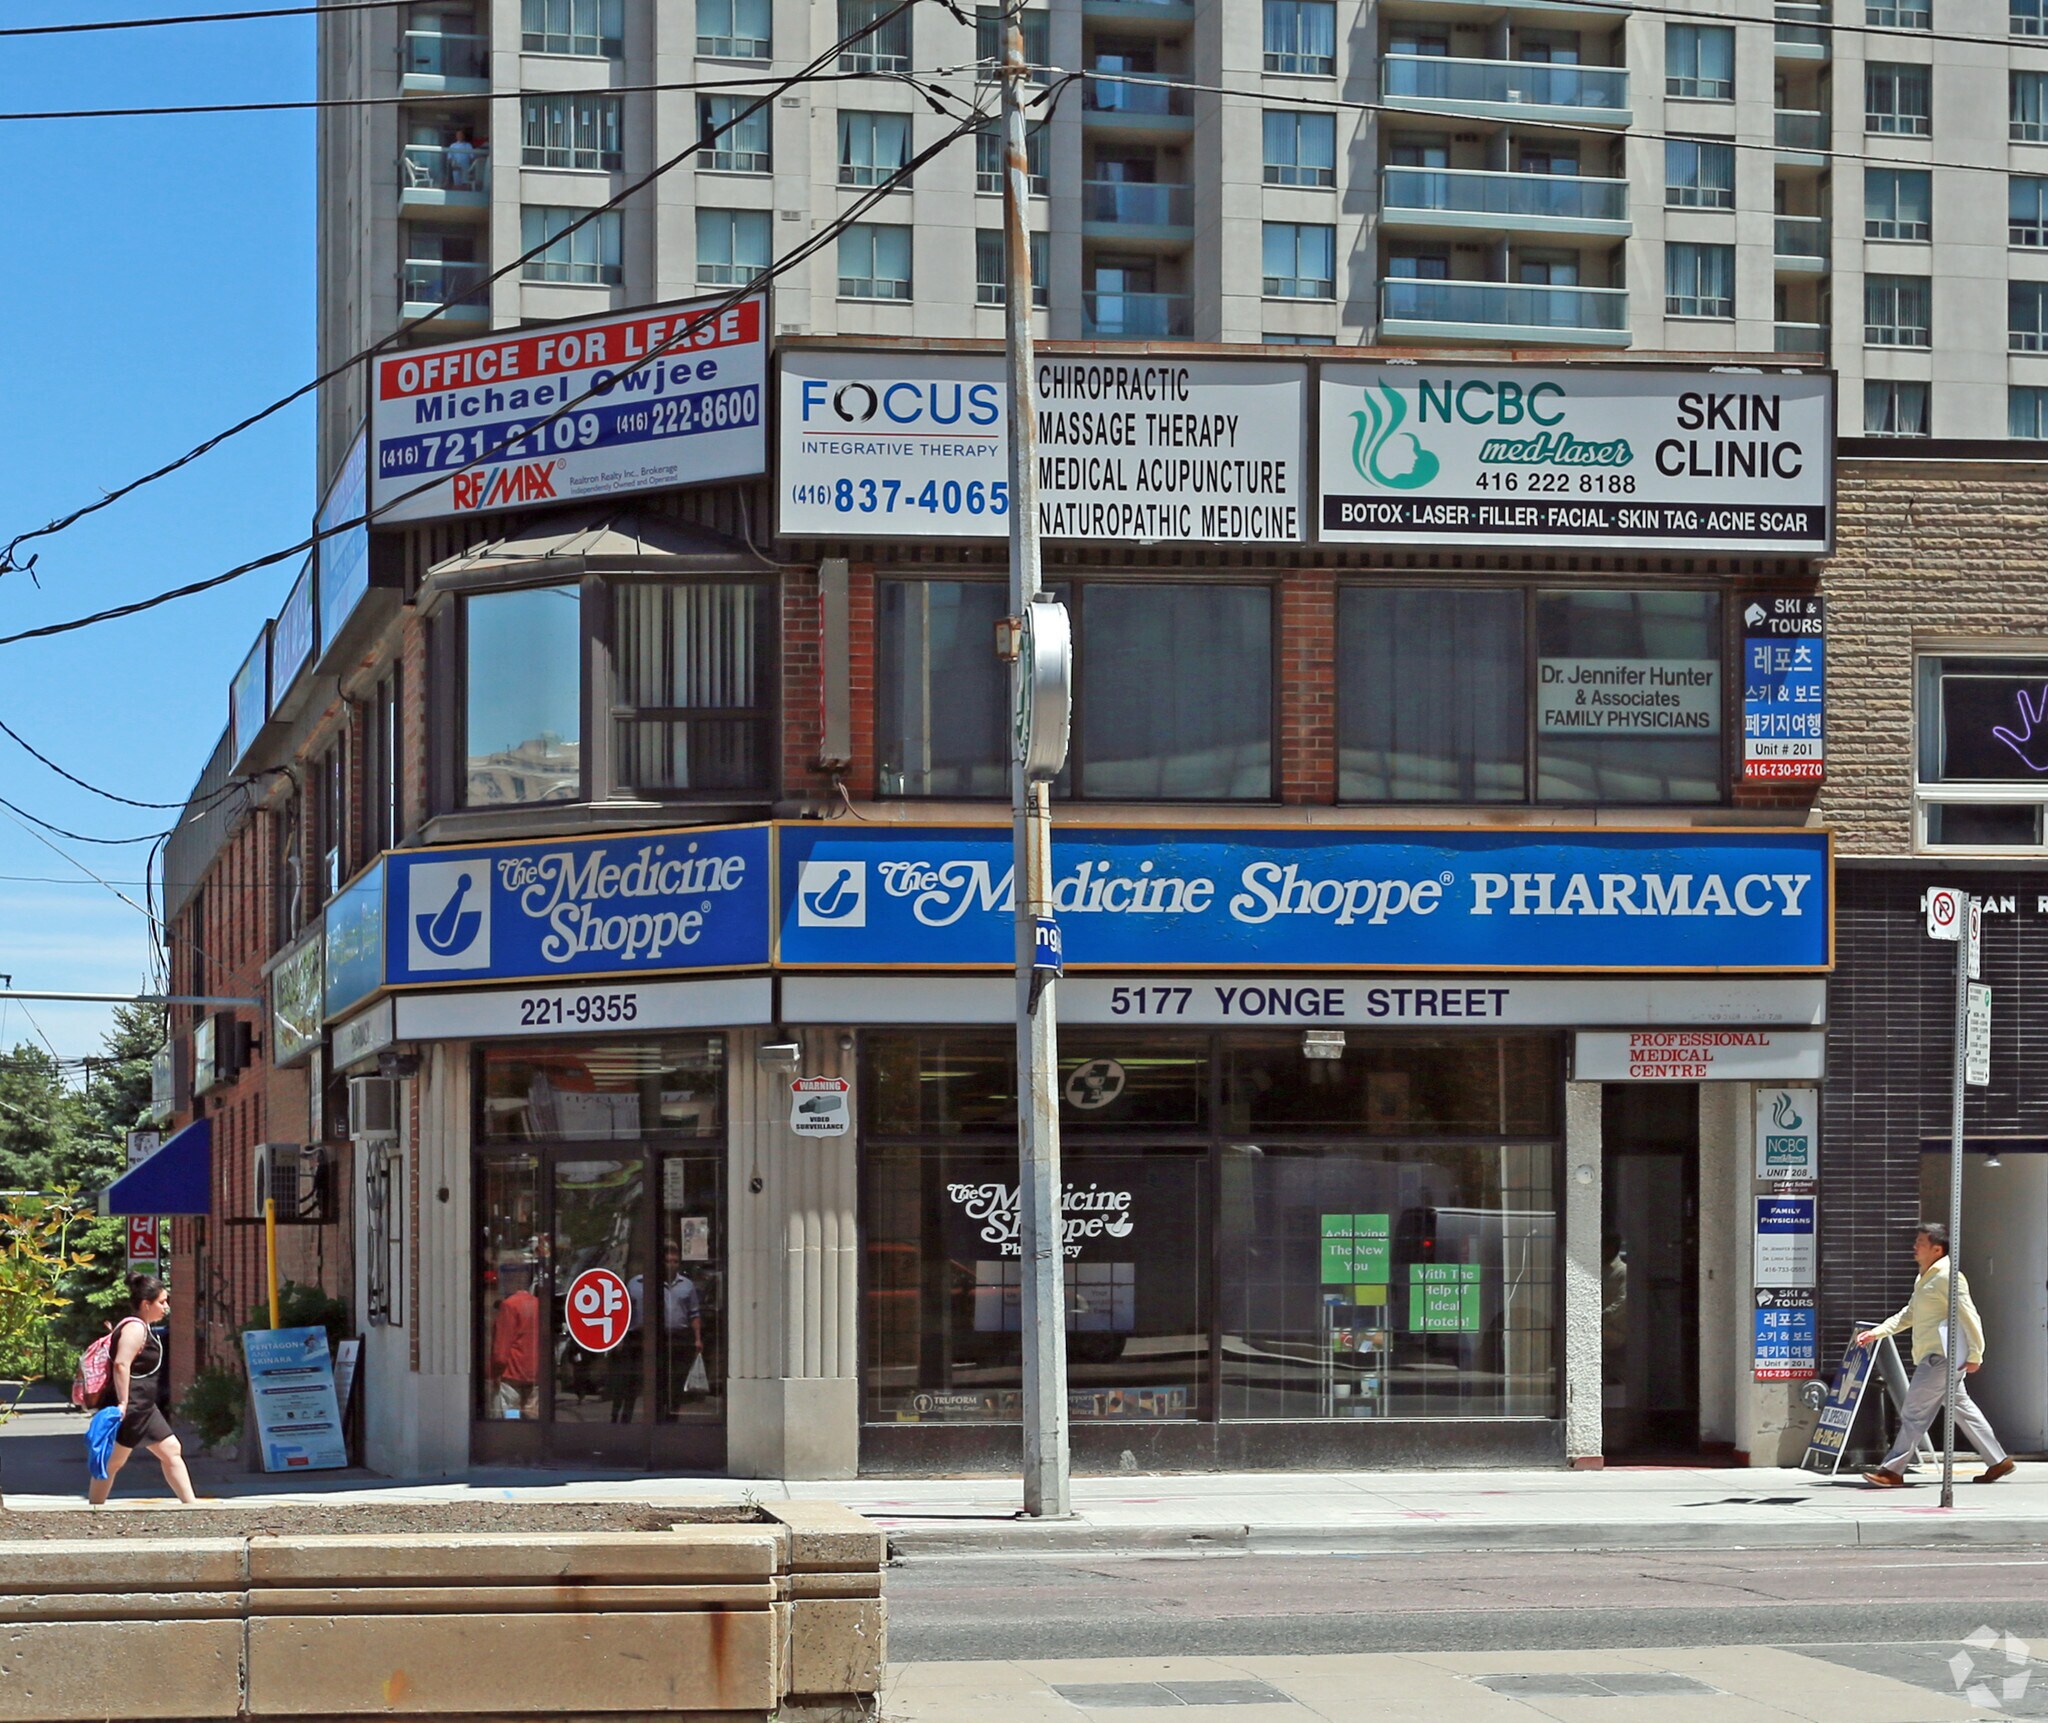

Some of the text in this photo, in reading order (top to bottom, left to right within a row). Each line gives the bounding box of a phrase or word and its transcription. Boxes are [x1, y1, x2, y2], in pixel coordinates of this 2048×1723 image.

[397, 308, 741, 393] OFFICE FOR LEASE
[414, 358, 719, 425] Michael Owjee
[1039, 365, 1190, 402] CHIROPRACTIC
[802, 380, 999, 426] FOCUS
[1418, 378, 1567, 427] NCBC
[1676, 391, 1781, 433] SKIN
[381, 389, 757, 469] (416) 721-2109 (416) 222-8600
[1039, 411, 1239, 449] MASSAGE THERAPY
[802, 440, 999, 458] INTEGRATIVE THERAPY
[1482, 432, 1632, 465] med-laser
[1654, 438, 1804, 480] CLINIC
[570, 475, 600, 486] Realtron
[600, 471, 622, 482] Realty
[640, 465, 678, 477] Brokerage
[613, 480, 636, 489] Owned
[636, 478, 648, 486] and
[648, 474, 678, 485] Operated
[1039, 457, 1287, 495] MEDICAL ACUPUNCTURE
[1475, 472, 1637, 495] 416 222 8188
[792, 478, 1010, 515] (416) 837-4065
[1039, 503, 1298, 539] NATUROPATHIC MEDICINE
[1341, 503, 1809, 533] BOTOX LASER FILLER FACIAL SKIN TAG ACNE SCAR
[1774, 598, 1818, 615] SKI &
[1768, 617, 1823, 634] TOURS
[1753, 645, 1813, 675] 레포츠
[1541, 664, 1714, 687] Dr. Jennifer Hunter
[1574, 689, 1681, 707] & Associates
[1744, 684, 1822, 705] 스키 & 보드
[1544, 709, 1711, 729] FAMILY PHYSICIANS
[1755, 743, 1813, 756] Unit # 201
[1744, 763, 1823, 778] 416-730-9770
[497, 841, 746, 918] The Medicine
[877, 860, 939, 897] The
[913, 860, 1215, 927] Mdicine
[1469, 872, 1812, 917] PHARMACY
[519, 992, 638, 1026] 221-9355
[1110, 987, 1510, 1018] 5177 YONGE STREET
[1629, 1033, 1770, 1047] PROFESSIONAL
[1629, 1049, 1714, 1063] MEDICAL
[1629, 1064, 1708, 1079] CENTRE
[800, 1081, 842, 1091] WARNING
[1768, 1138, 1807, 1153] NCBC
[1766, 1168, 1808, 1177] UNIT 208
[947, 1183, 1132, 1219] The Micine
[1325, 1229, 1388, 1242] Achieving
[1000, 1243, 1083, 1259] Phcy
[1329, 1244, 1384, 1255] The New
[1343, 1260, 1369, 1271] You
[1417, 1268, 1474, 1280] With The
[1425, 1284, 1469, 1297] Help of
[1779, 1289, 1798, 1297] SKI
[574, 1277, 624, 1345] 약
[1429, 1300, 1460, 1311] Ideal
[1774, 1299, 1814, 1308] TOURS
[1419, 1315, 1470, 1328] Protein!
[1763, 1312, 1807, 1328] 레포츠
[1757, 1331, 1813, 1343] 스키 & 보드
[249, 1342, 299, 1351] PENTAGON
[252, 1356, 292, 1366] SKINARA
[1757, 1370, 1813, 1378] 416-730-9770
[933, 1396, 977, 1405] TRUFORM
